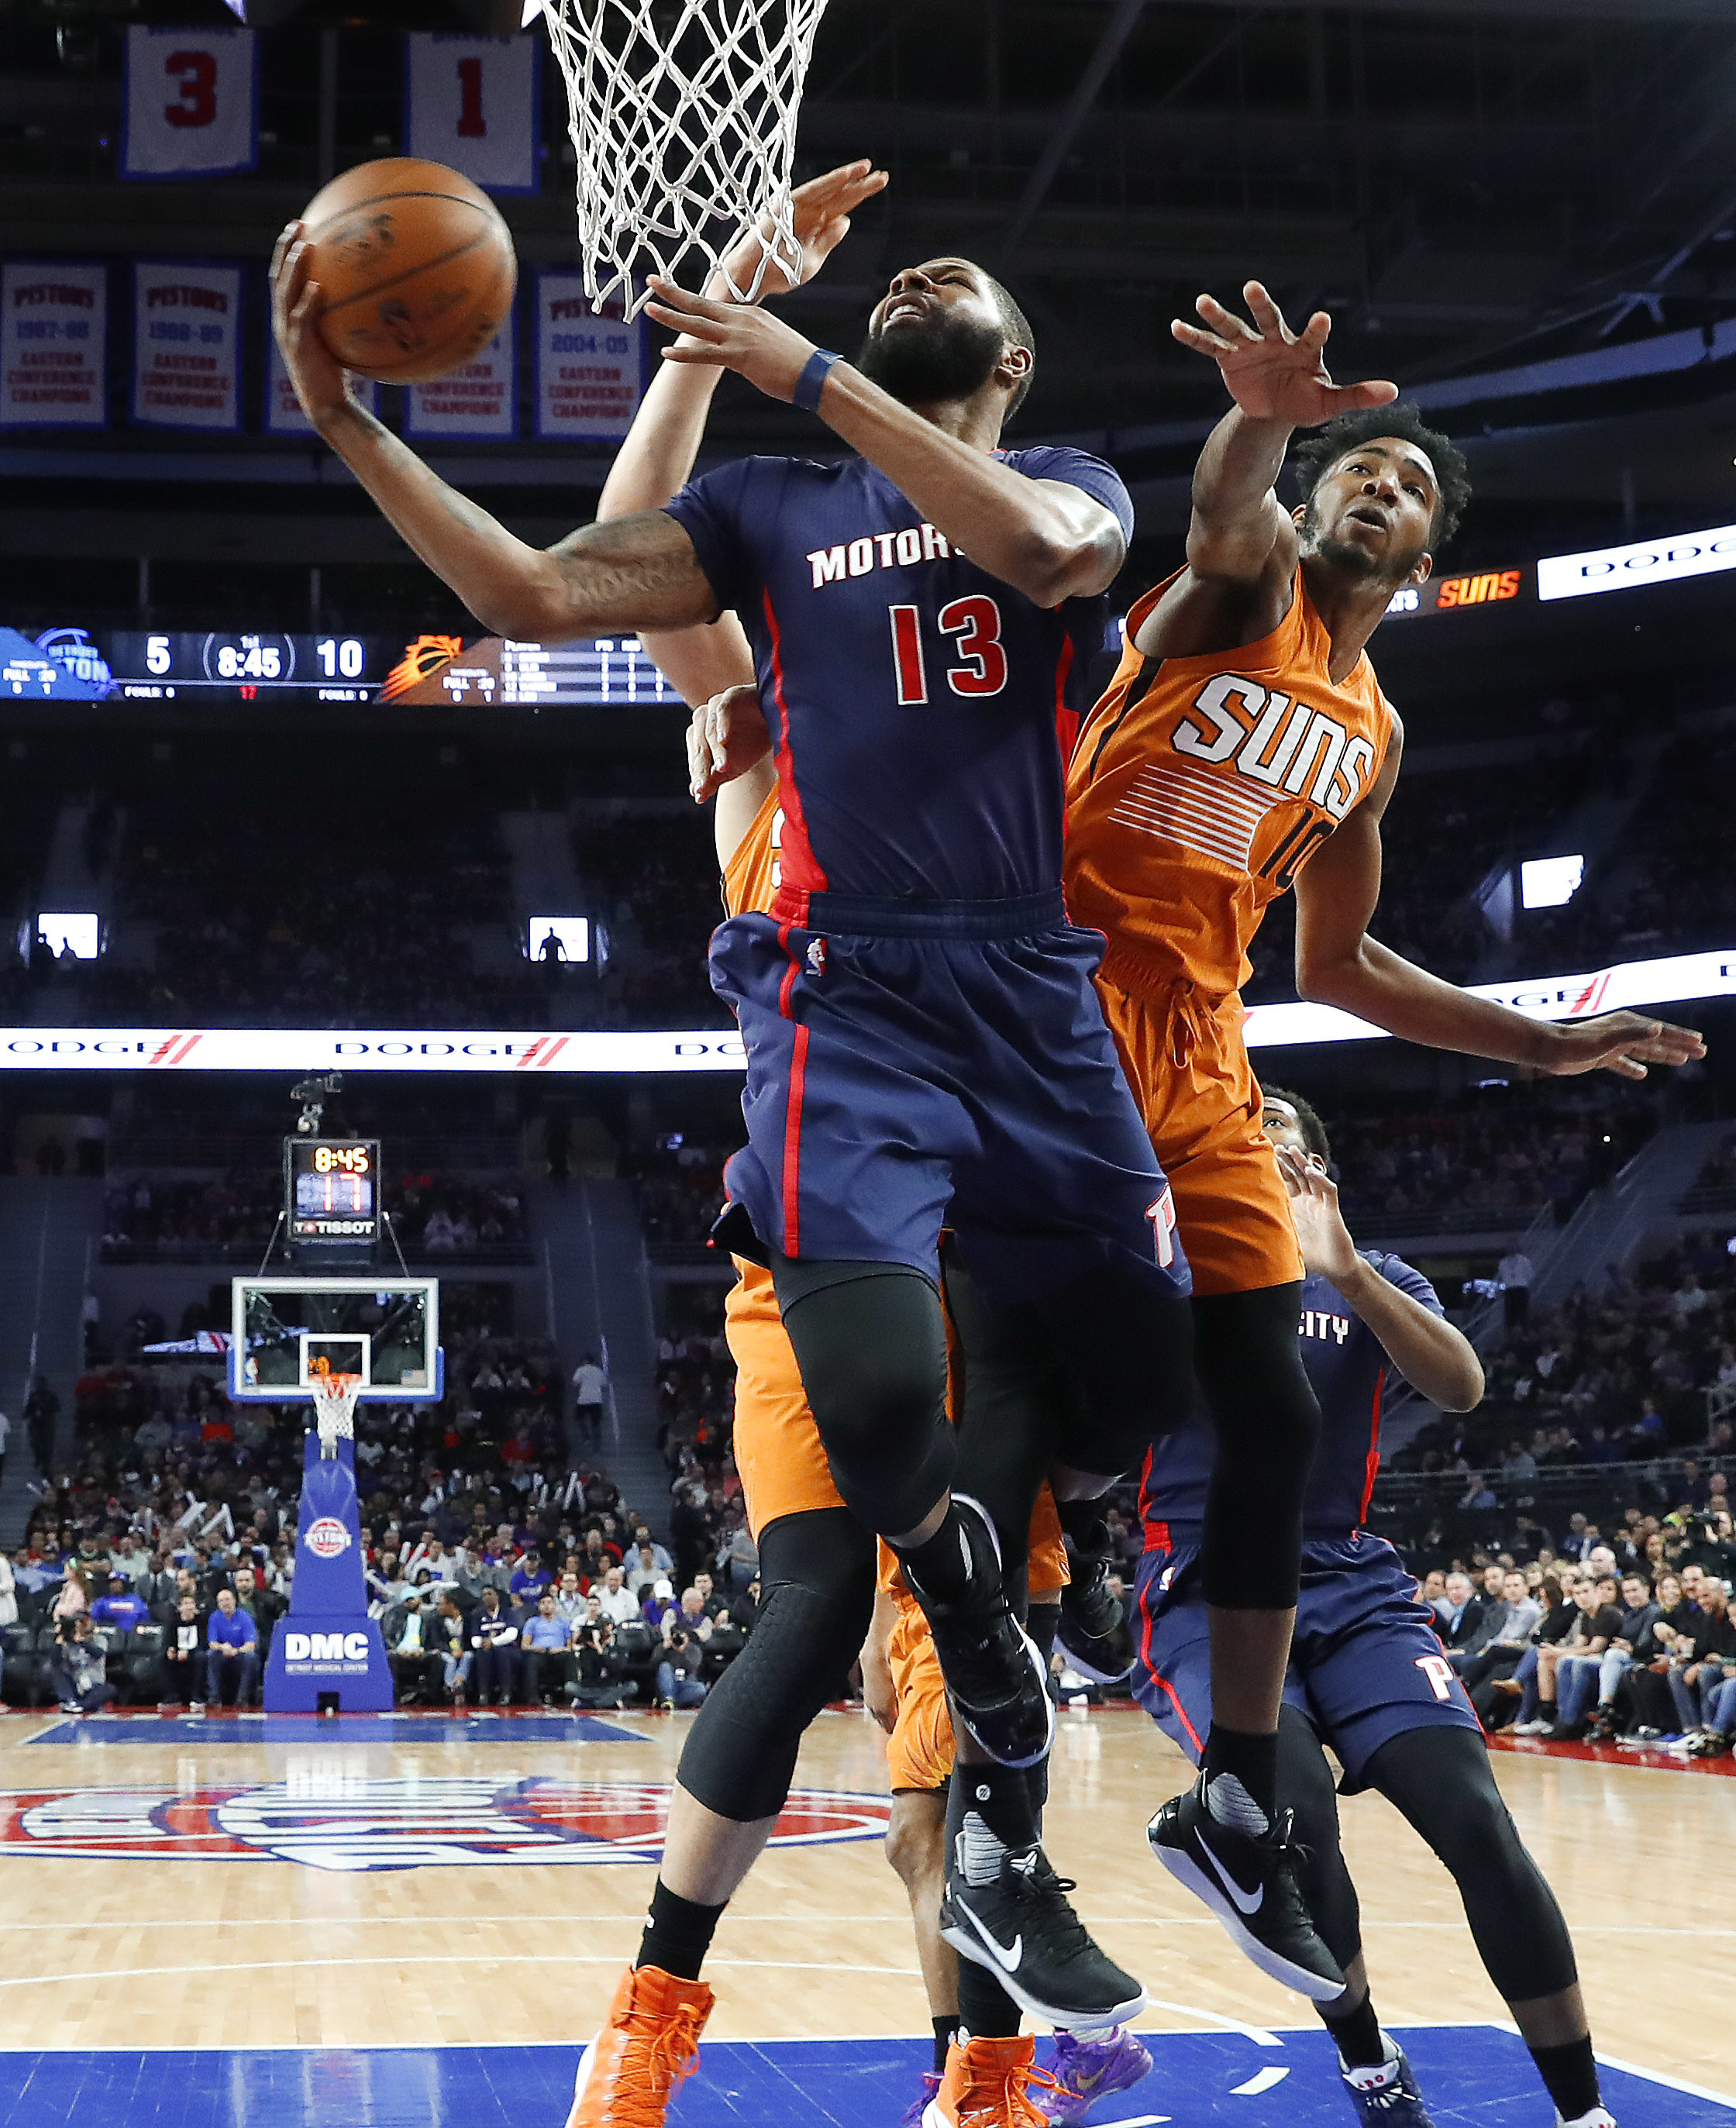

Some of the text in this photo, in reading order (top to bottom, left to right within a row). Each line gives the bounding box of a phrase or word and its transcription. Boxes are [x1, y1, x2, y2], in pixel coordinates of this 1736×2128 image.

[164, 51, 216, 128] 3
[457, 57, 487, 138] 1
[551, 334, 629, 354] 2004-05
[1438, 570, 1521, 608] SUNS
[146, 635, 171, 675] 5
[217, 646, 281, 678] 8:45
[316, 639, 363, 677] 10
[887, 594, 1008, 706] 13
[239, 685, 258, 699] 17
[1171, 673, 1376, 821] SUNS
[336, 1042, 536, 1056] DODGE
[315, 1146, 369, 1172] 8:45
[323, 1172, 363, 1212] 17
[316, 1221, 376, 1234] TISSOT
[284, 1632, 370, 1661] DMC
